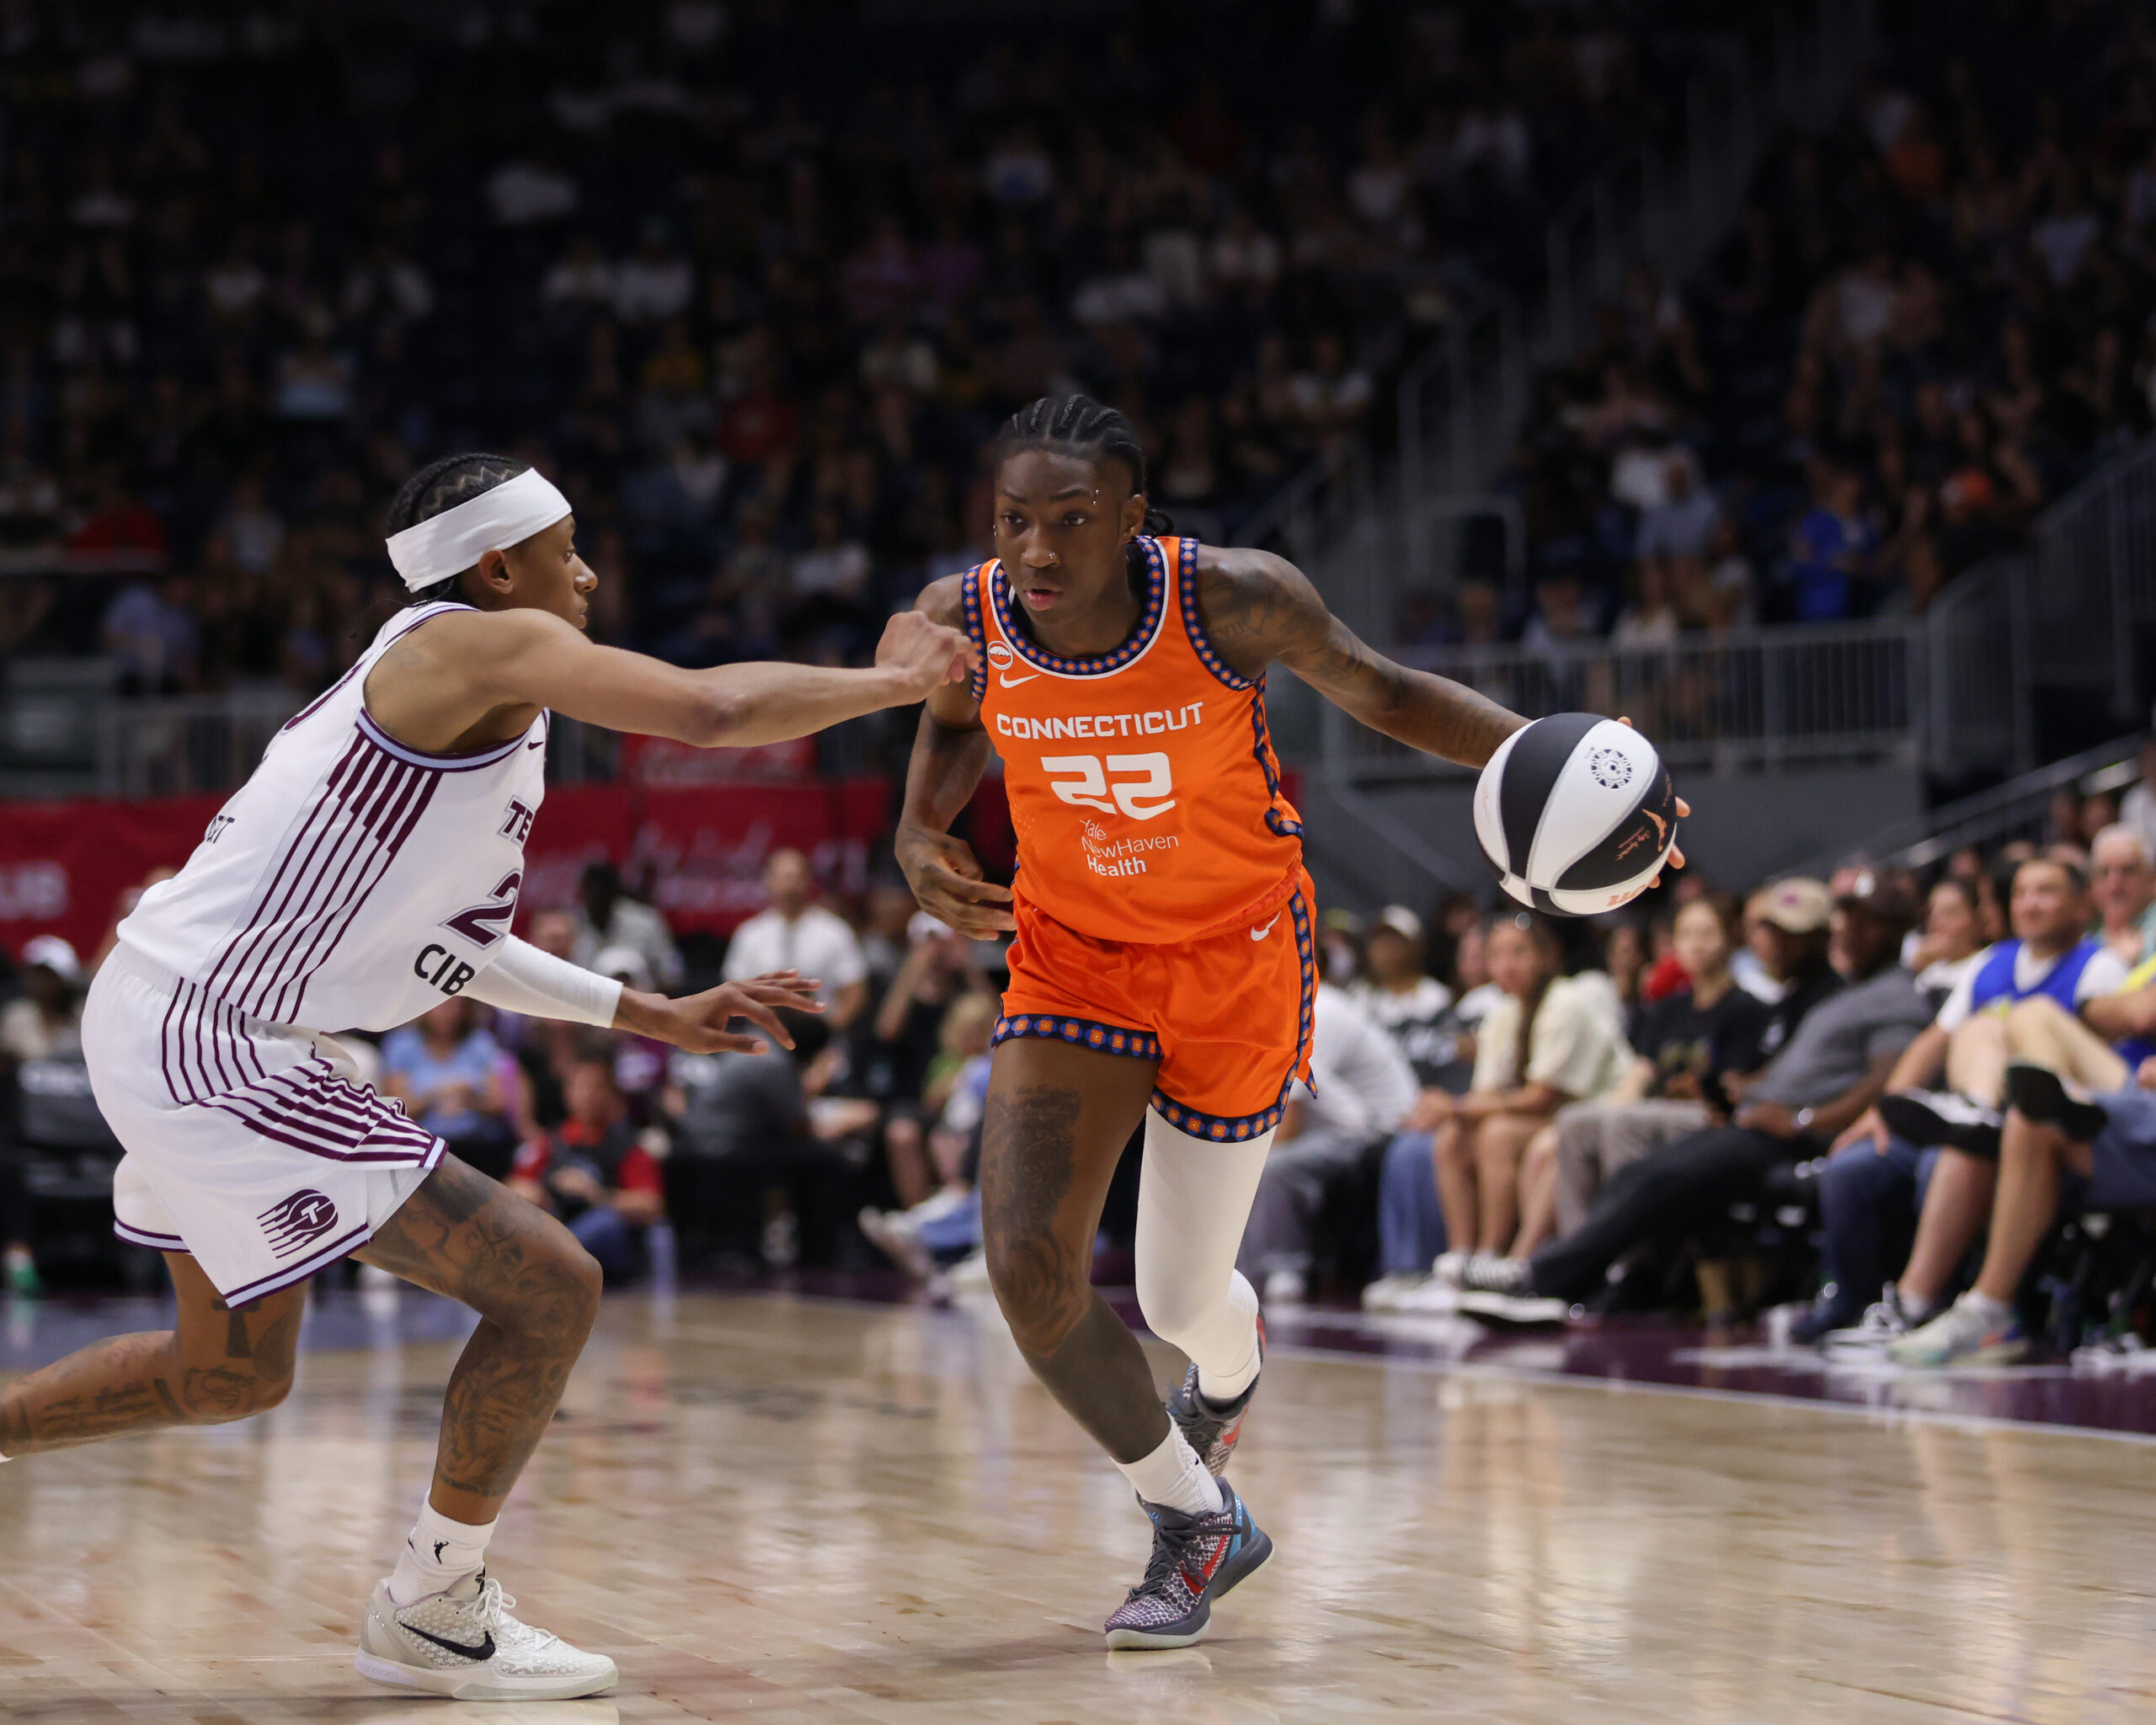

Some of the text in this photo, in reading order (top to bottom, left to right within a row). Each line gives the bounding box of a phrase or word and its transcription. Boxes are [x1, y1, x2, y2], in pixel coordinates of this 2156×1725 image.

[996, 702, 1203, 740] CONNECTICUT
[1040, 751, 1176, 820] 22
[1079, 819, 1107, 841] Yale
[1081, 836, 1179, 858] NewHaven
[1086, 856, 1147, 877] Health
